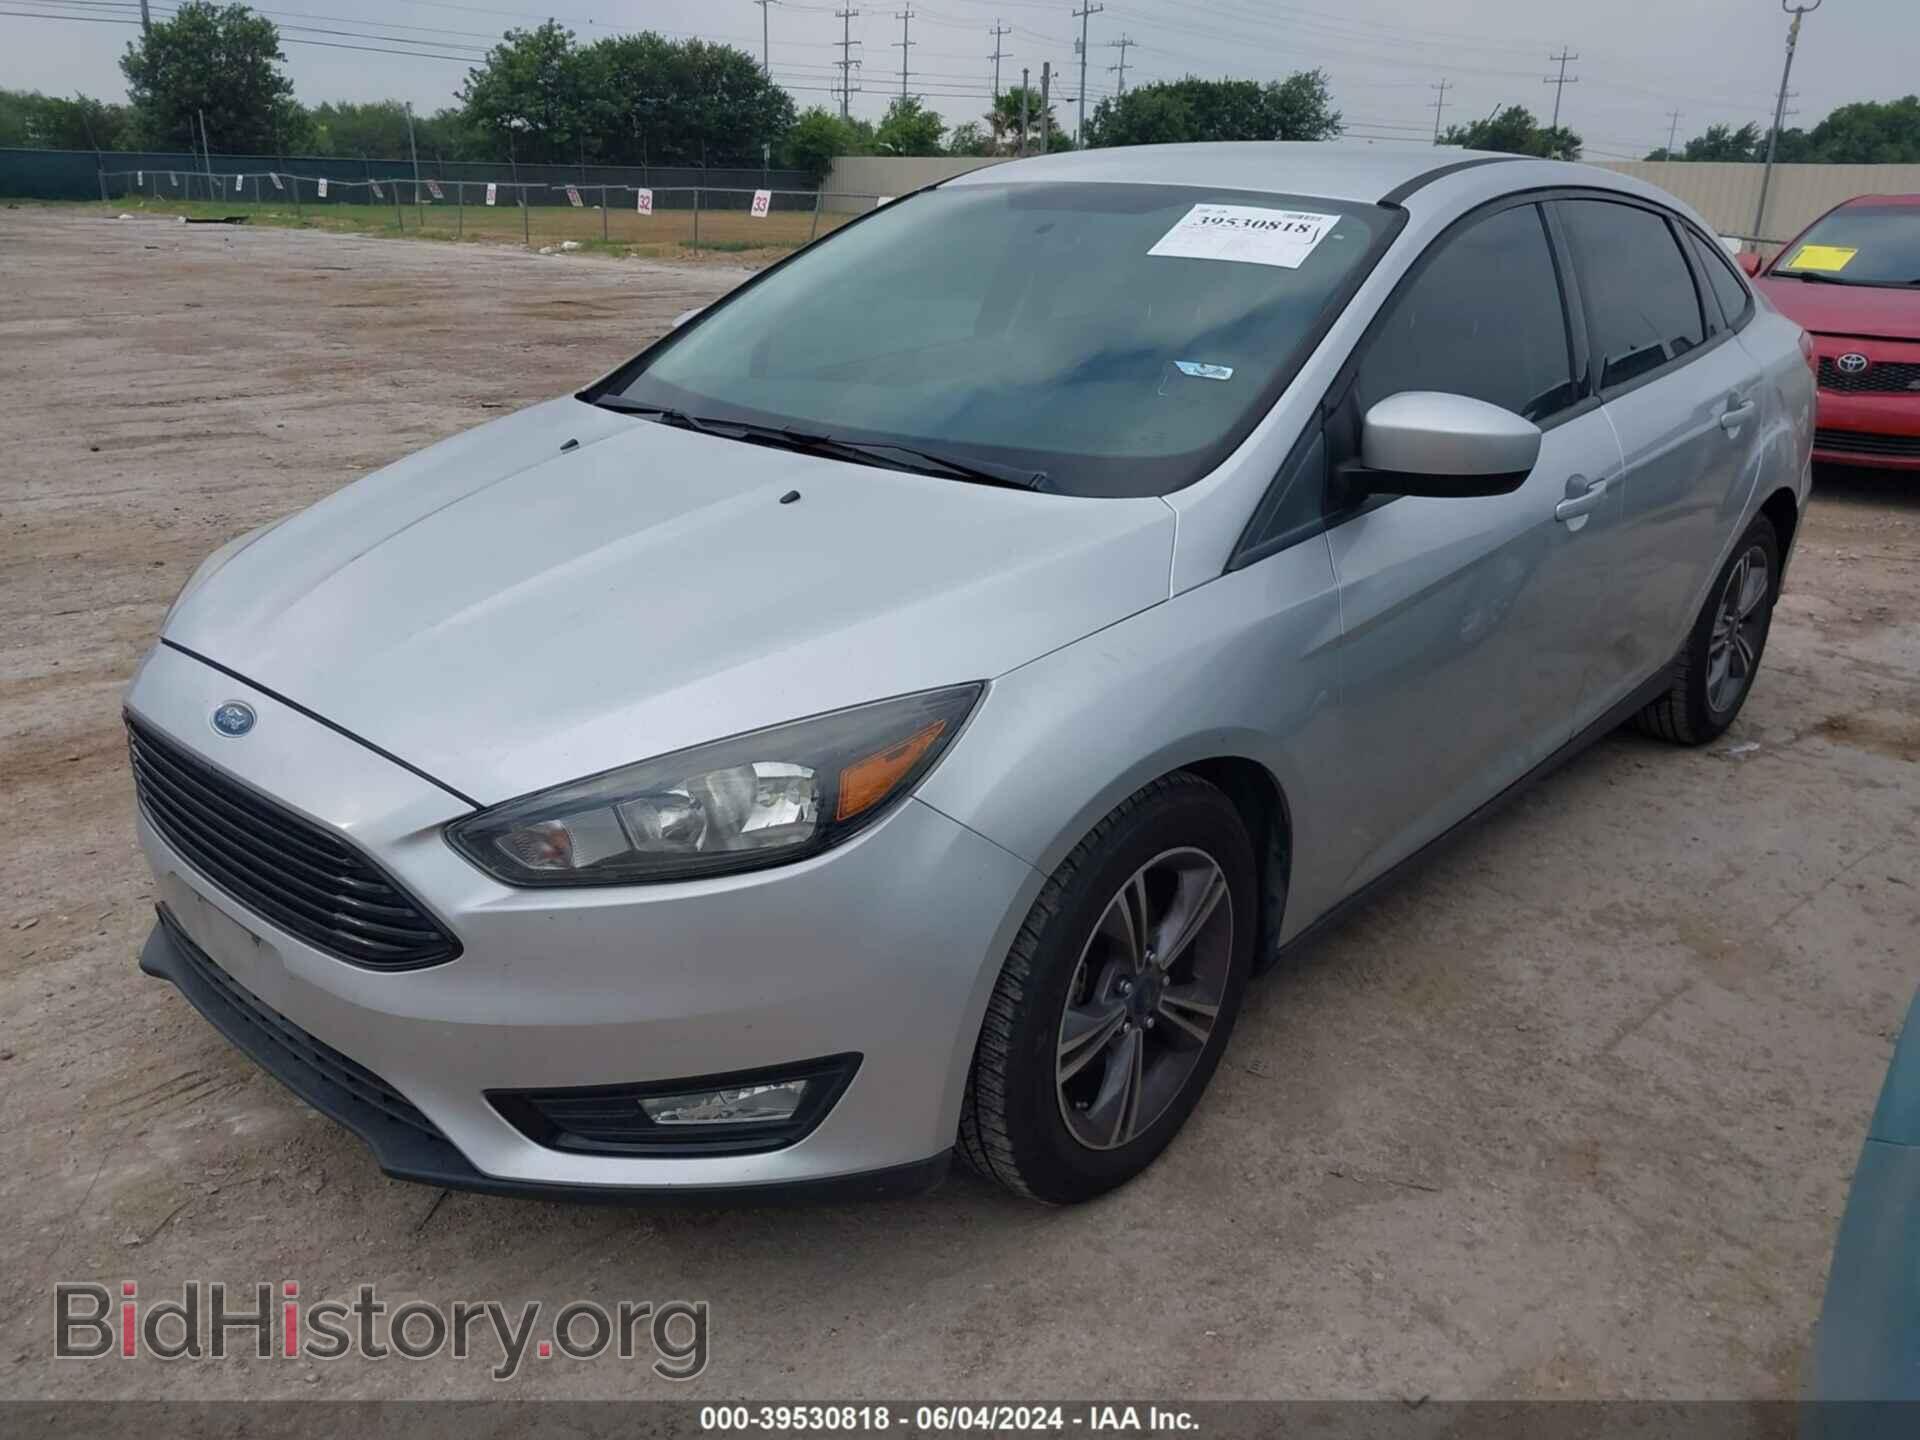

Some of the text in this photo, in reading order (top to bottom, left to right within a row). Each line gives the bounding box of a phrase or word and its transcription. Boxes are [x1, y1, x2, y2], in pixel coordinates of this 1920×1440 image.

[639, 194, 650, 210] 32
[754, 196, 768, 212] 33
[1193, 216, 1311, 233] 39530818
